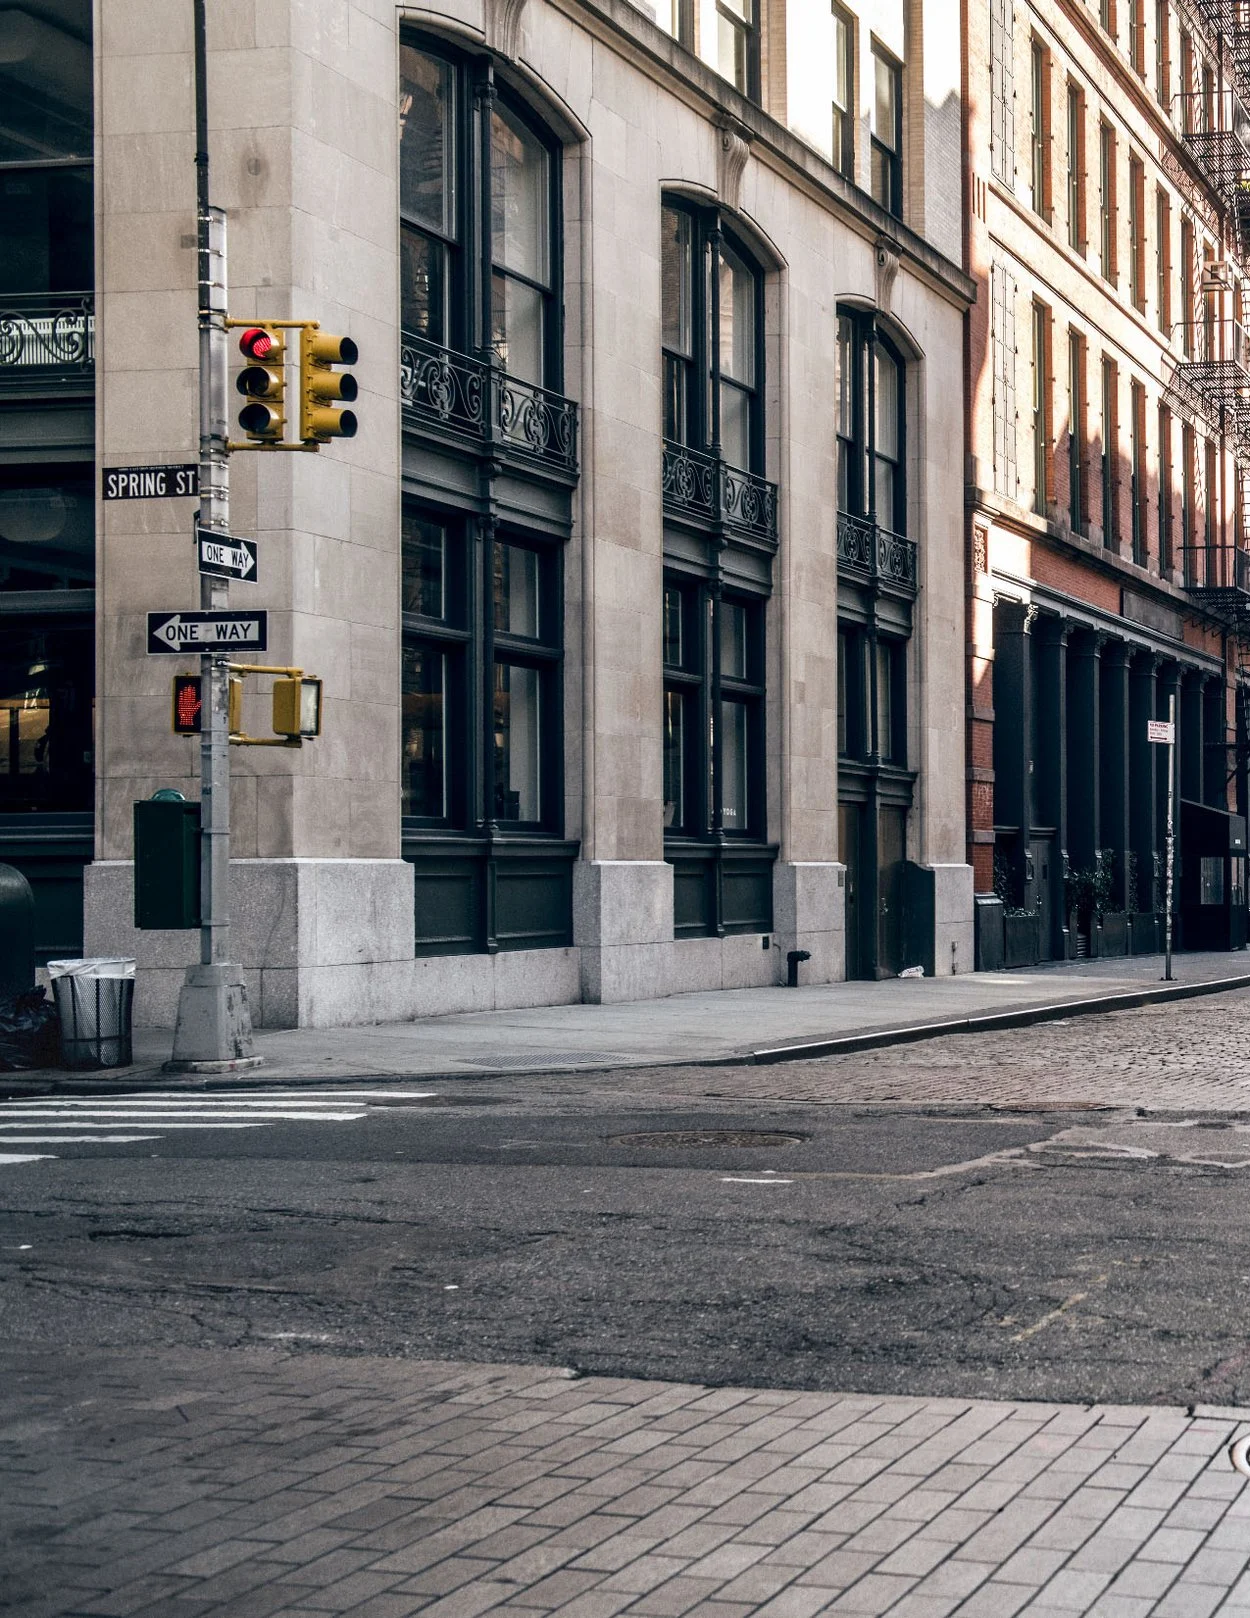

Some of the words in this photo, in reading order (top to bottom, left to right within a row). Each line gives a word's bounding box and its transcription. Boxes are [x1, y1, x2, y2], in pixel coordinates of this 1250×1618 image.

[108, 472, 166, 498] SPRING
[176, 470, 195, 495] ST
[207, 544, 224, 564] ONE
[231, 549, 249, 569] WAY
[165, 624, 199, 641] ONE
[215, 623, 252, 640] WAY
